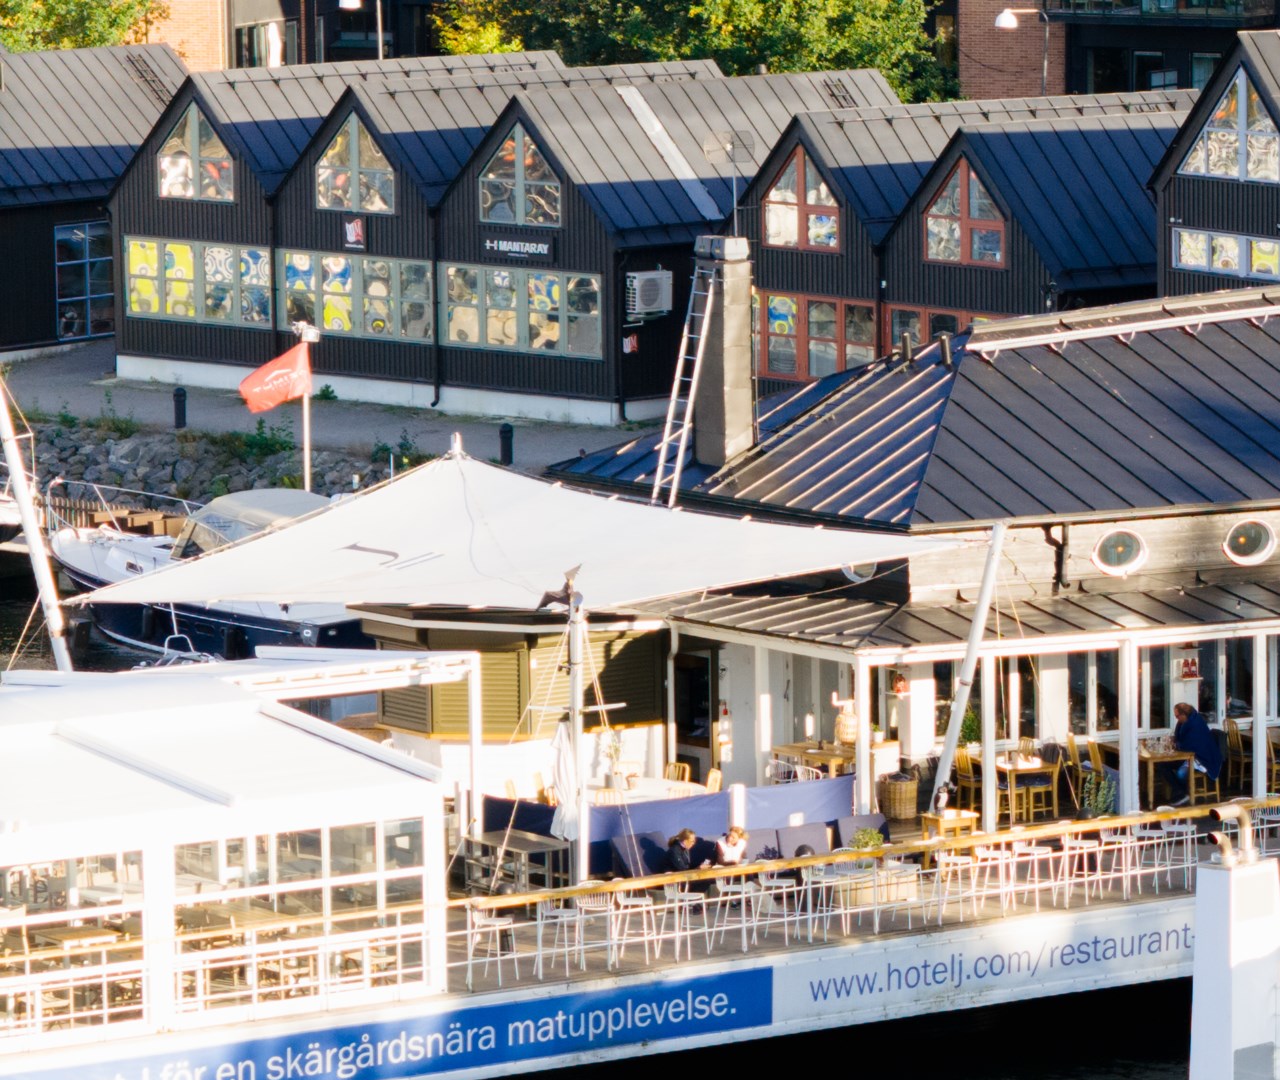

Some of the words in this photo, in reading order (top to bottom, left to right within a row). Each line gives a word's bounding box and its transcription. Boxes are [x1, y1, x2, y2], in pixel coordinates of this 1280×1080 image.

[498, 240, 550, 255] MANTARAY
[266, 1023, 496, 1080] skärgårdsnära
[508, 990, 736, 1045] matupplevelse.
